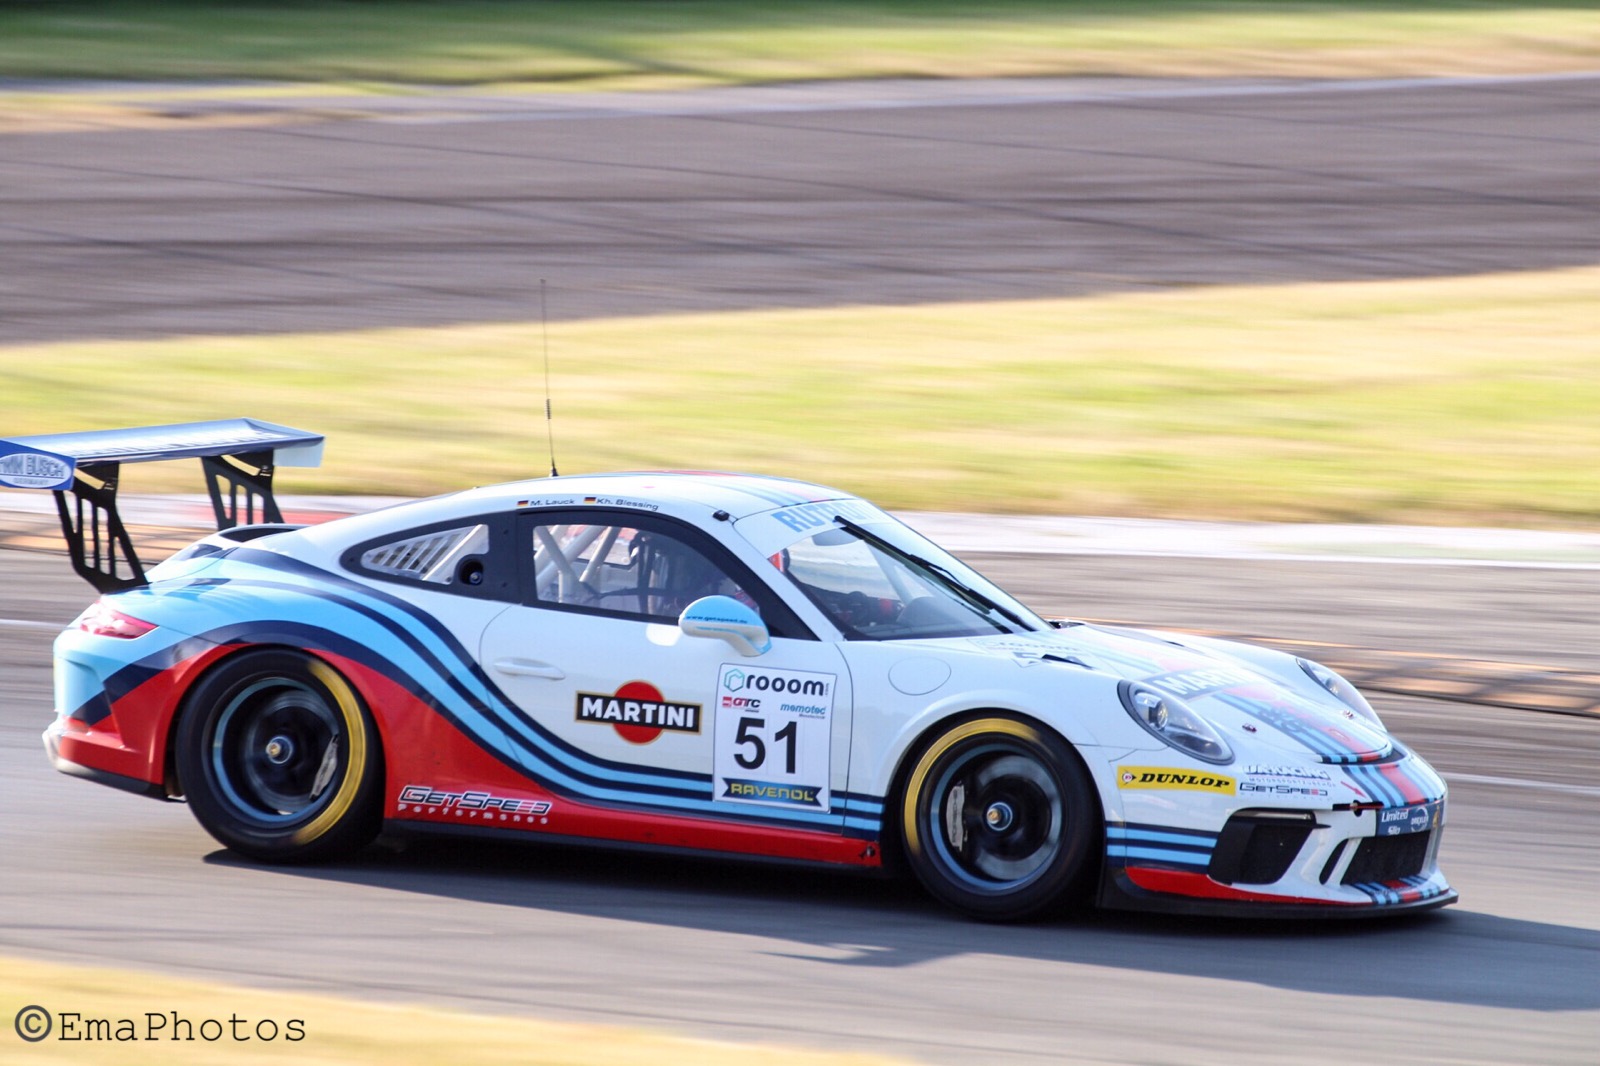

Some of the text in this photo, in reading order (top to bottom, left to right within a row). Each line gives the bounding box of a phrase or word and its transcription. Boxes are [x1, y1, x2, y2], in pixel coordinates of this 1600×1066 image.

[26, 454, 64, 477] BUSCH
[545, 498, 575, 506] Lauck
[615, 499, 659, 511] Blessing
[746, 674, 824, 697] rooom
[582, 697, 695, 728] MARTINI
[733, 716, 798, 774] 51
[1139, 772, 1231, 790] DUNLOP
[730, 783, 815, 802] RAVENOL
[1381, 809, 1409, 823] Limited
